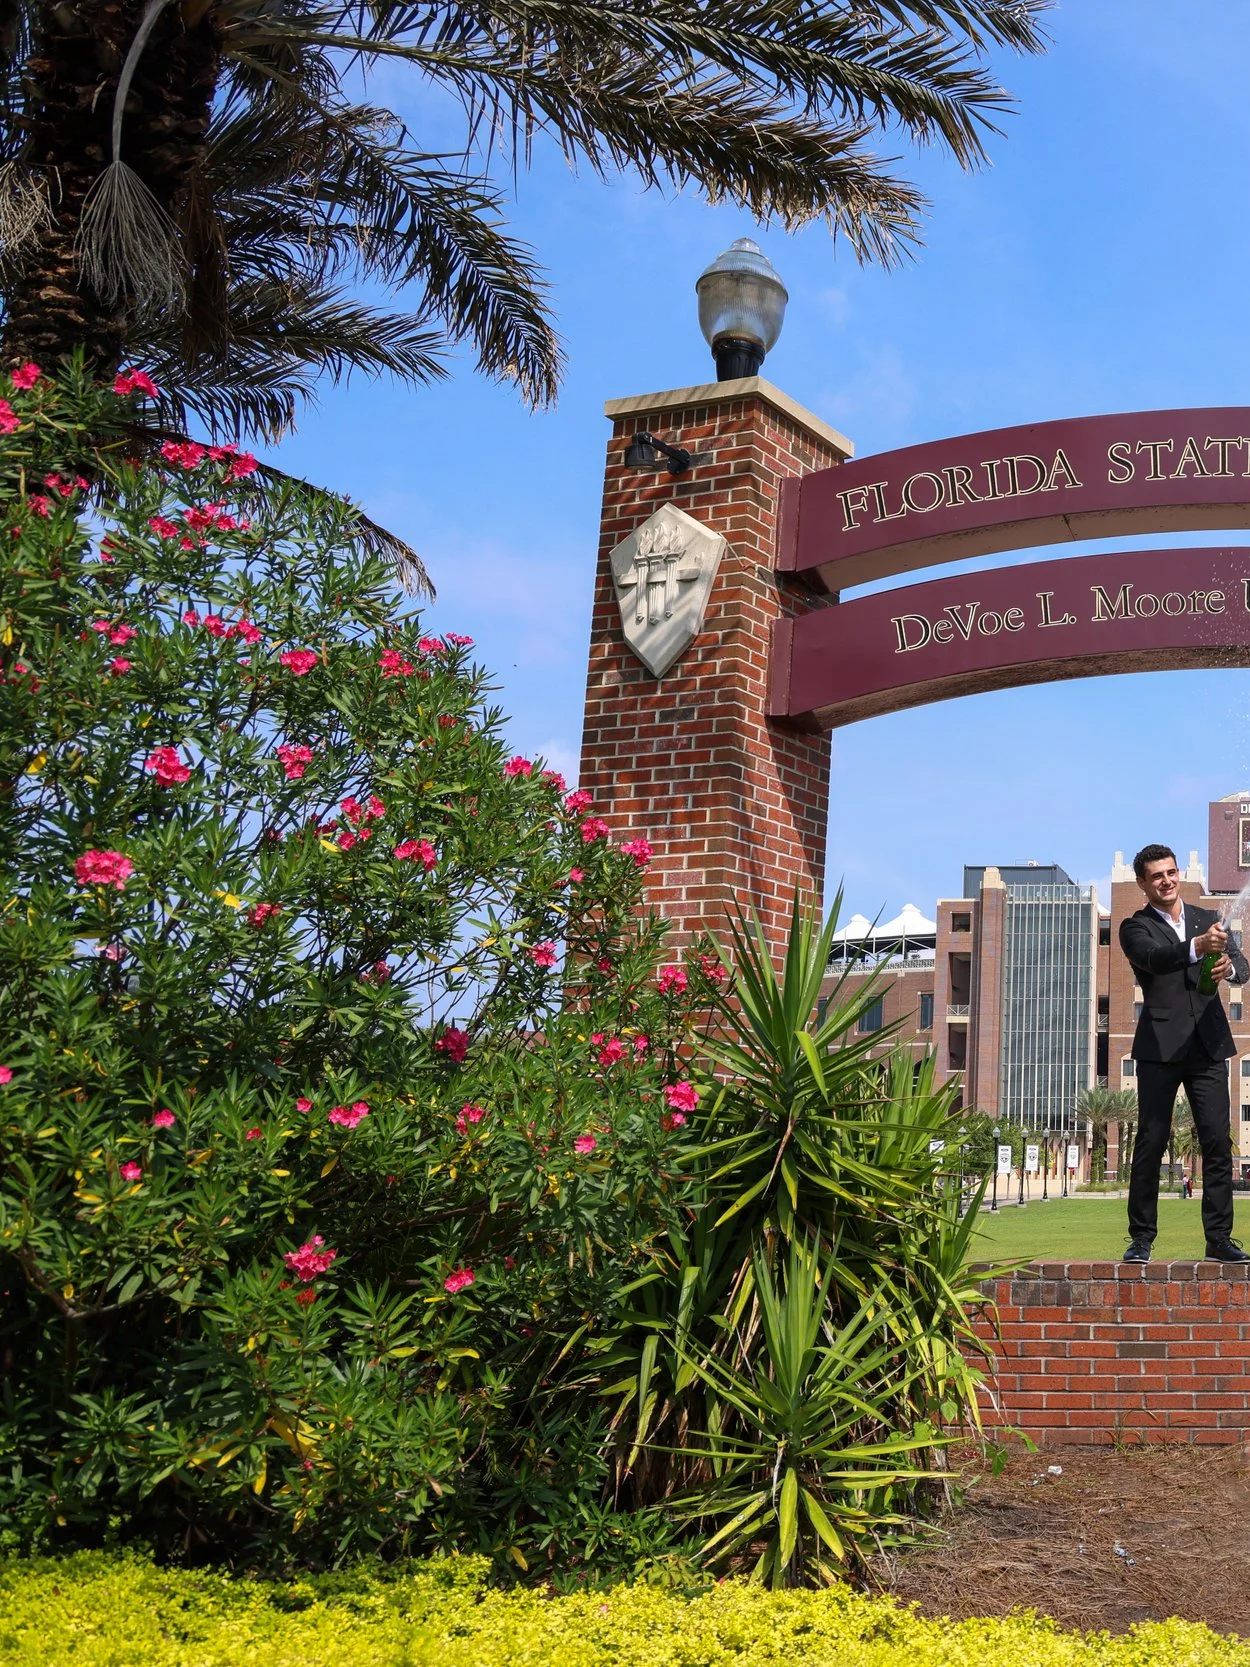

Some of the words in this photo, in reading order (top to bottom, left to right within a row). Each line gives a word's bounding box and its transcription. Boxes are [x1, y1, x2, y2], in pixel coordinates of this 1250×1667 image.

[835, 448, 1083, 532] FLORIDA
[892, 601, 1025, 654] DeVoe
[1036, 591, 1078, 628] L.
[1090, 583, 1226, 622] Moore
